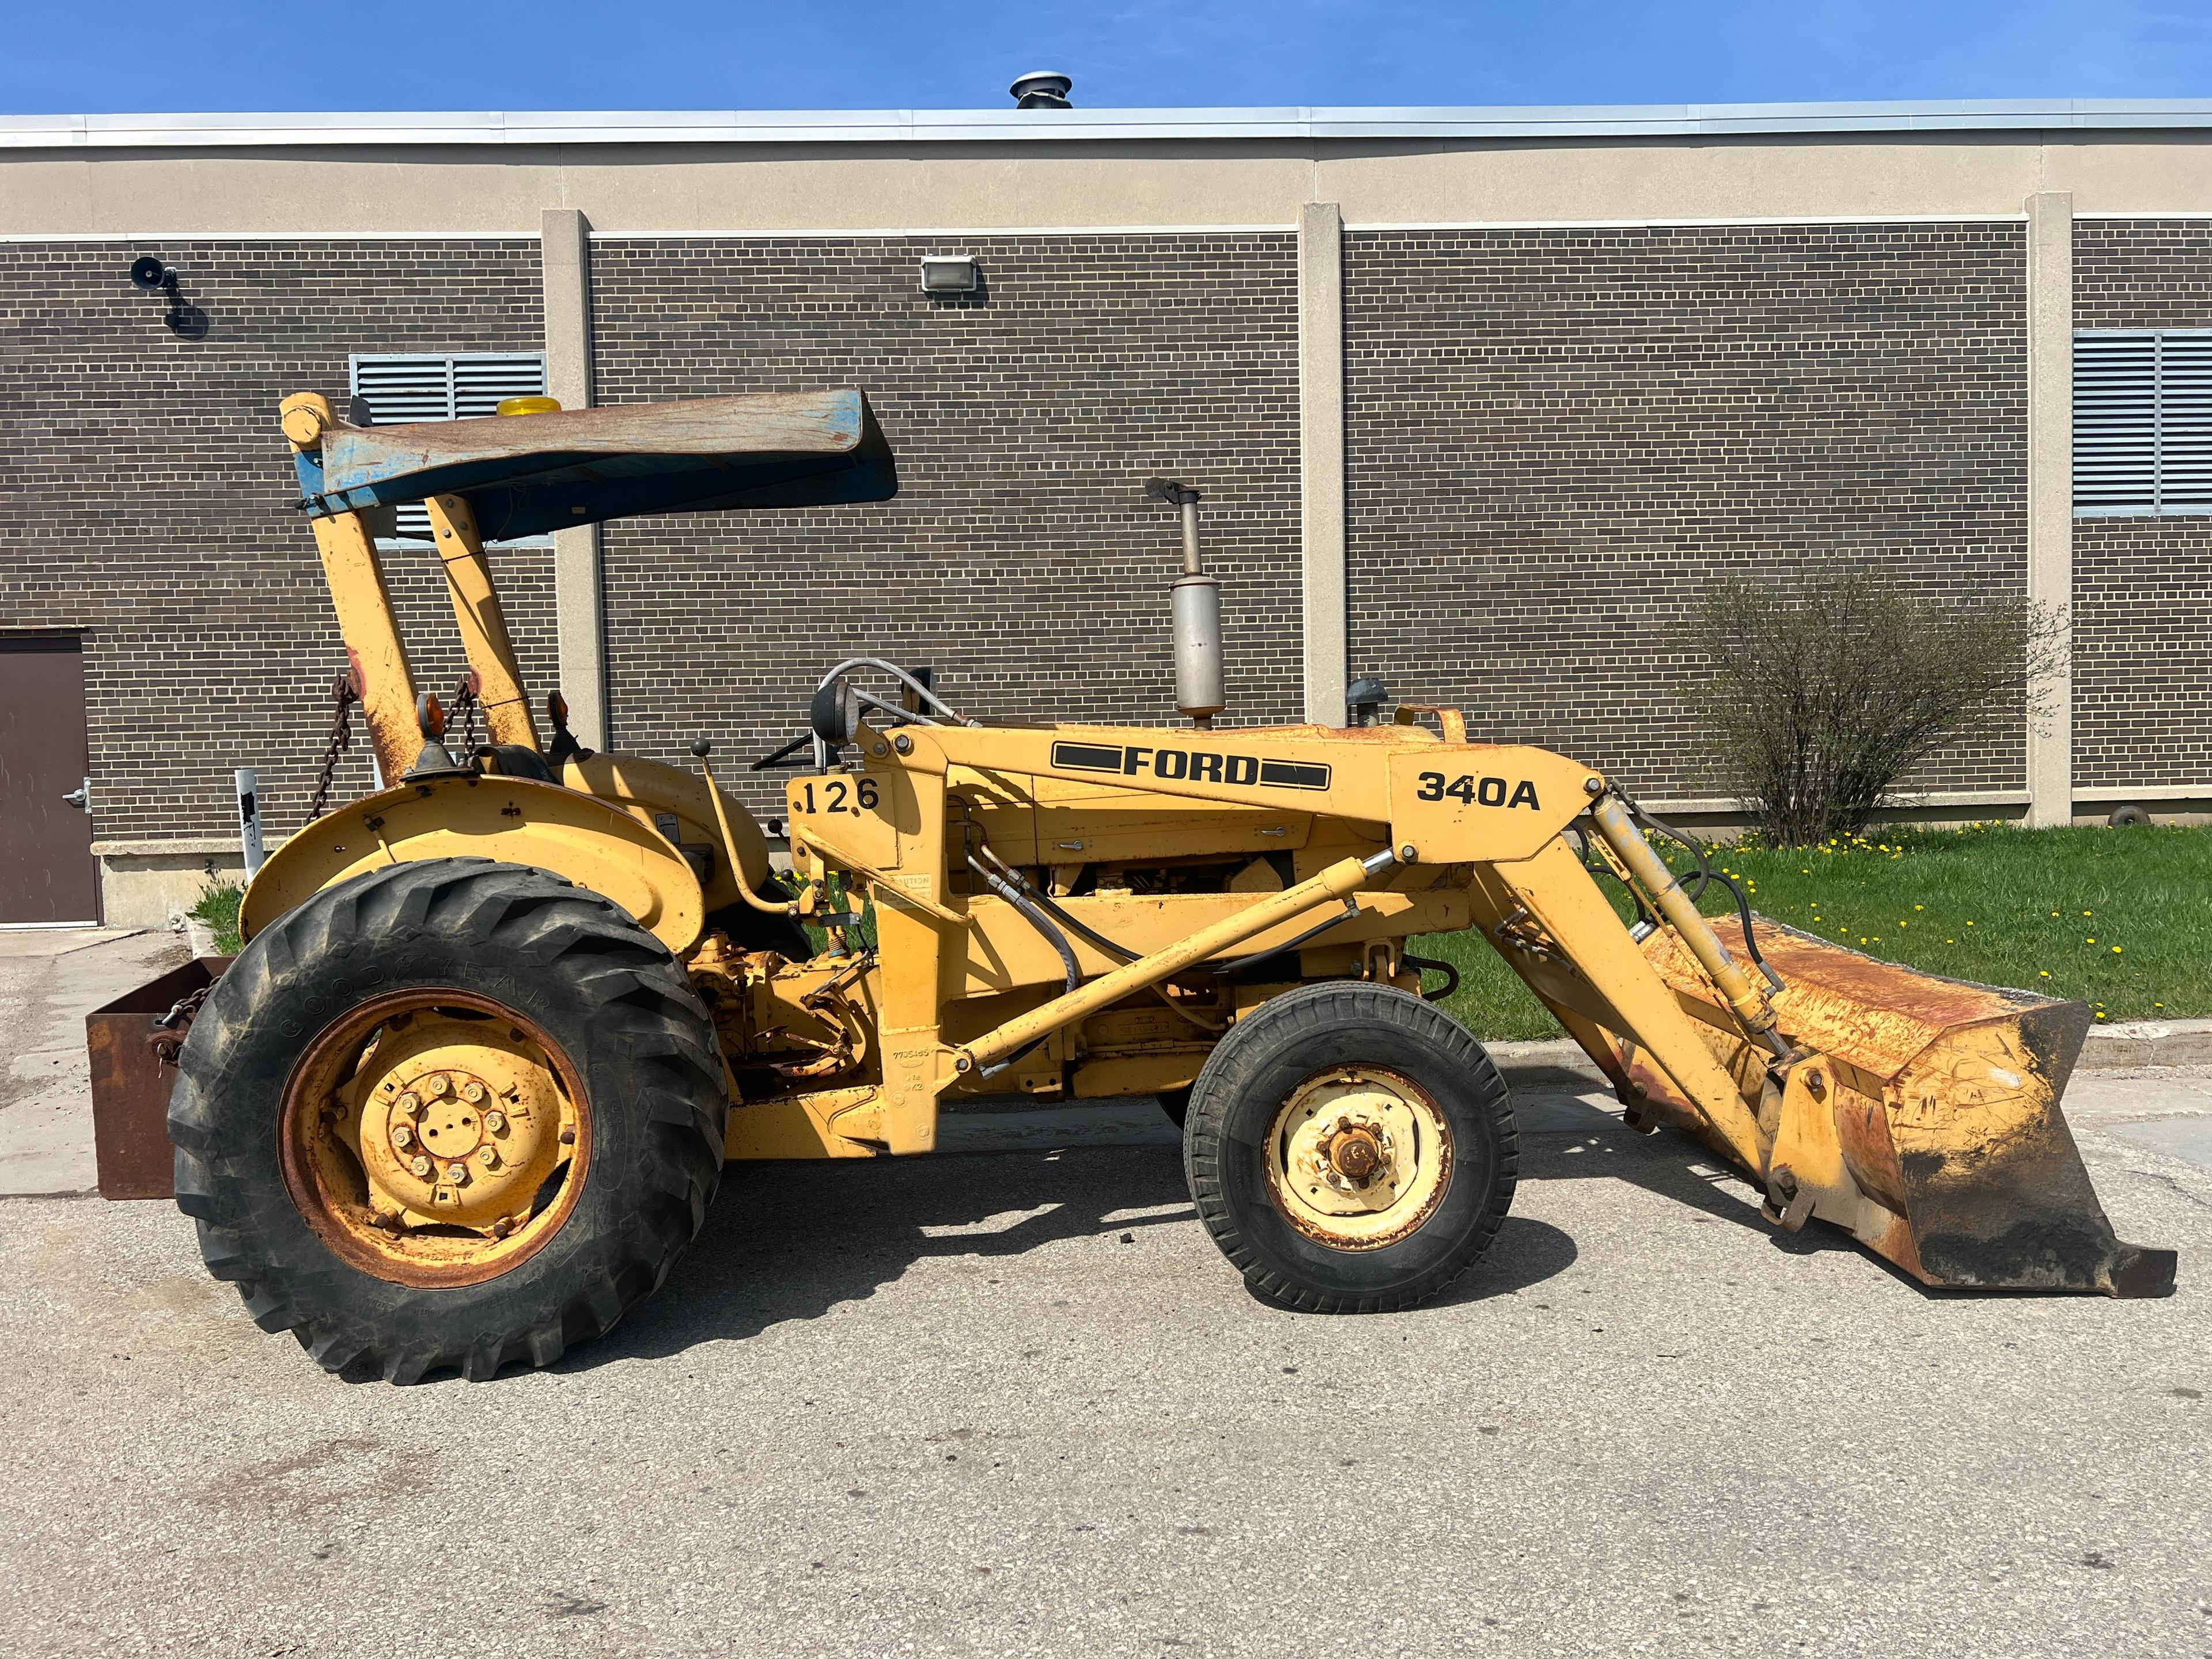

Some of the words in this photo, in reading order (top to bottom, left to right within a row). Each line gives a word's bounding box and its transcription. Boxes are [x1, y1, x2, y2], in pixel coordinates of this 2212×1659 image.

[1123, 746, 1259, 786] FORD
[804, 778, 879, 814] 126
[1417, 771, 1540, 811] 340A
